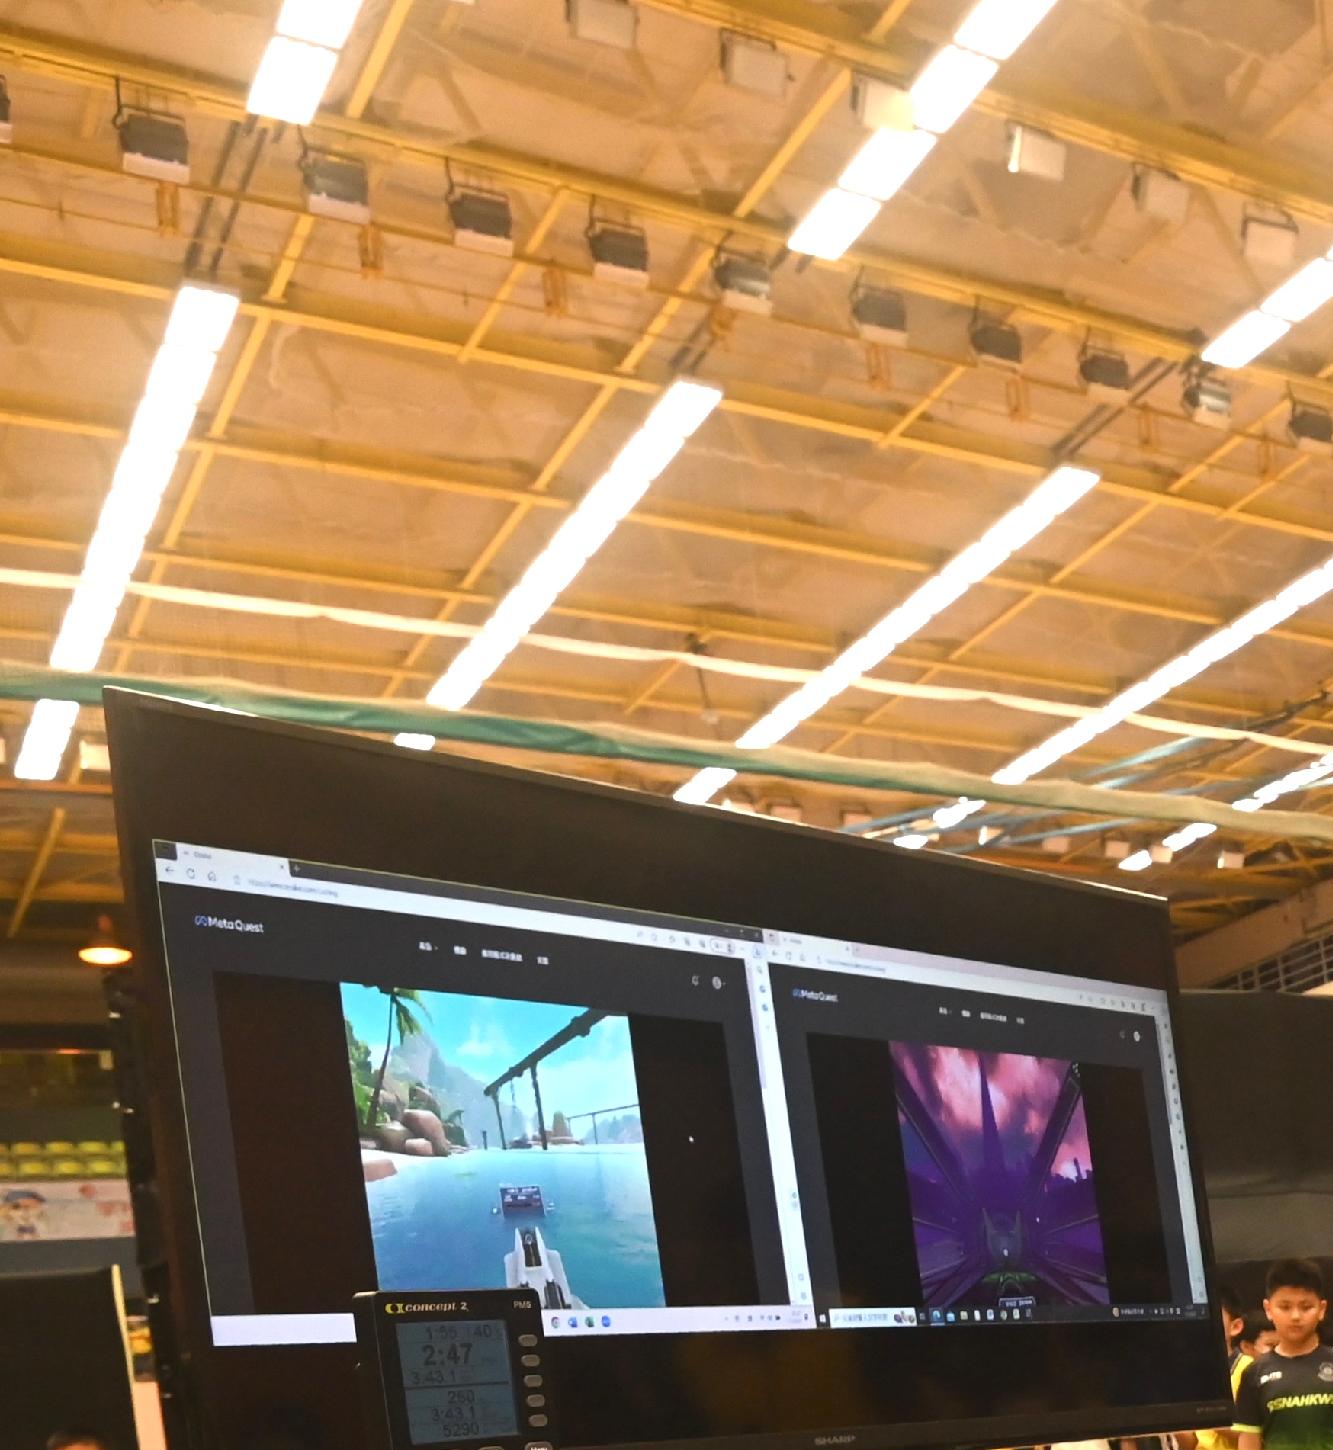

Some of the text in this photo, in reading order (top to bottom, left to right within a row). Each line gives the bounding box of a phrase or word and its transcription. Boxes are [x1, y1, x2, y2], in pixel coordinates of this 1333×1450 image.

[208, 915, 264, 933] Meta Quest
[405, 1302, 456, 1312] concept
[422, 1343, 472, 1366] 2:47
[815, 1435, 856, 1446] SHARP
